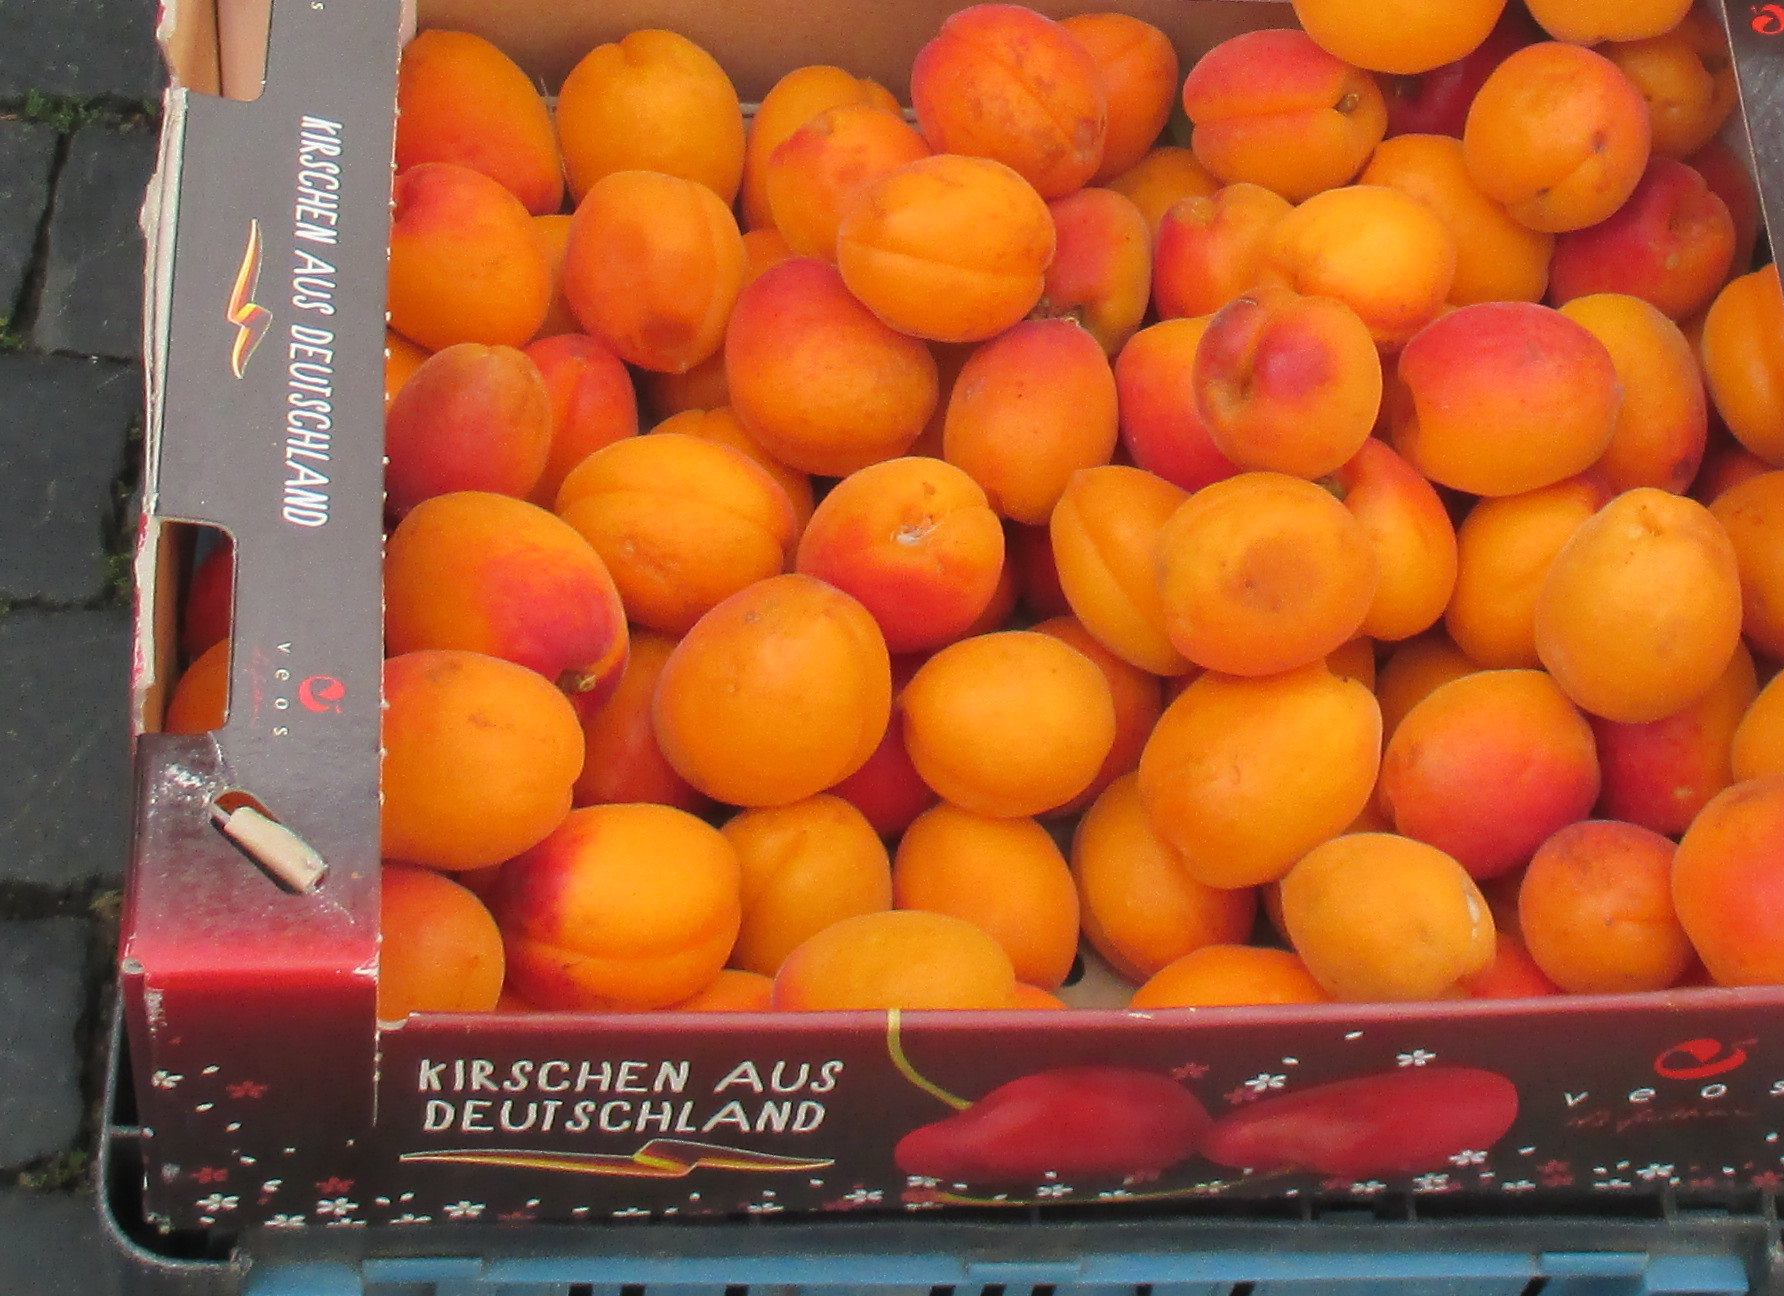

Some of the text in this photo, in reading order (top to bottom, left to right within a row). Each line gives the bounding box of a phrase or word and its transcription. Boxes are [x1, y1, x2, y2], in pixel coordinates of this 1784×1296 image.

[281, 115, 343, 528] KIRSCHEN AUS DEUTSCHLAND
[272, 641, 292, 737] veos
[417, 1058, 845, 1094] KIRSCHEN AUS
[422, 1099, 826, 1134] DEUTSCHLAND
